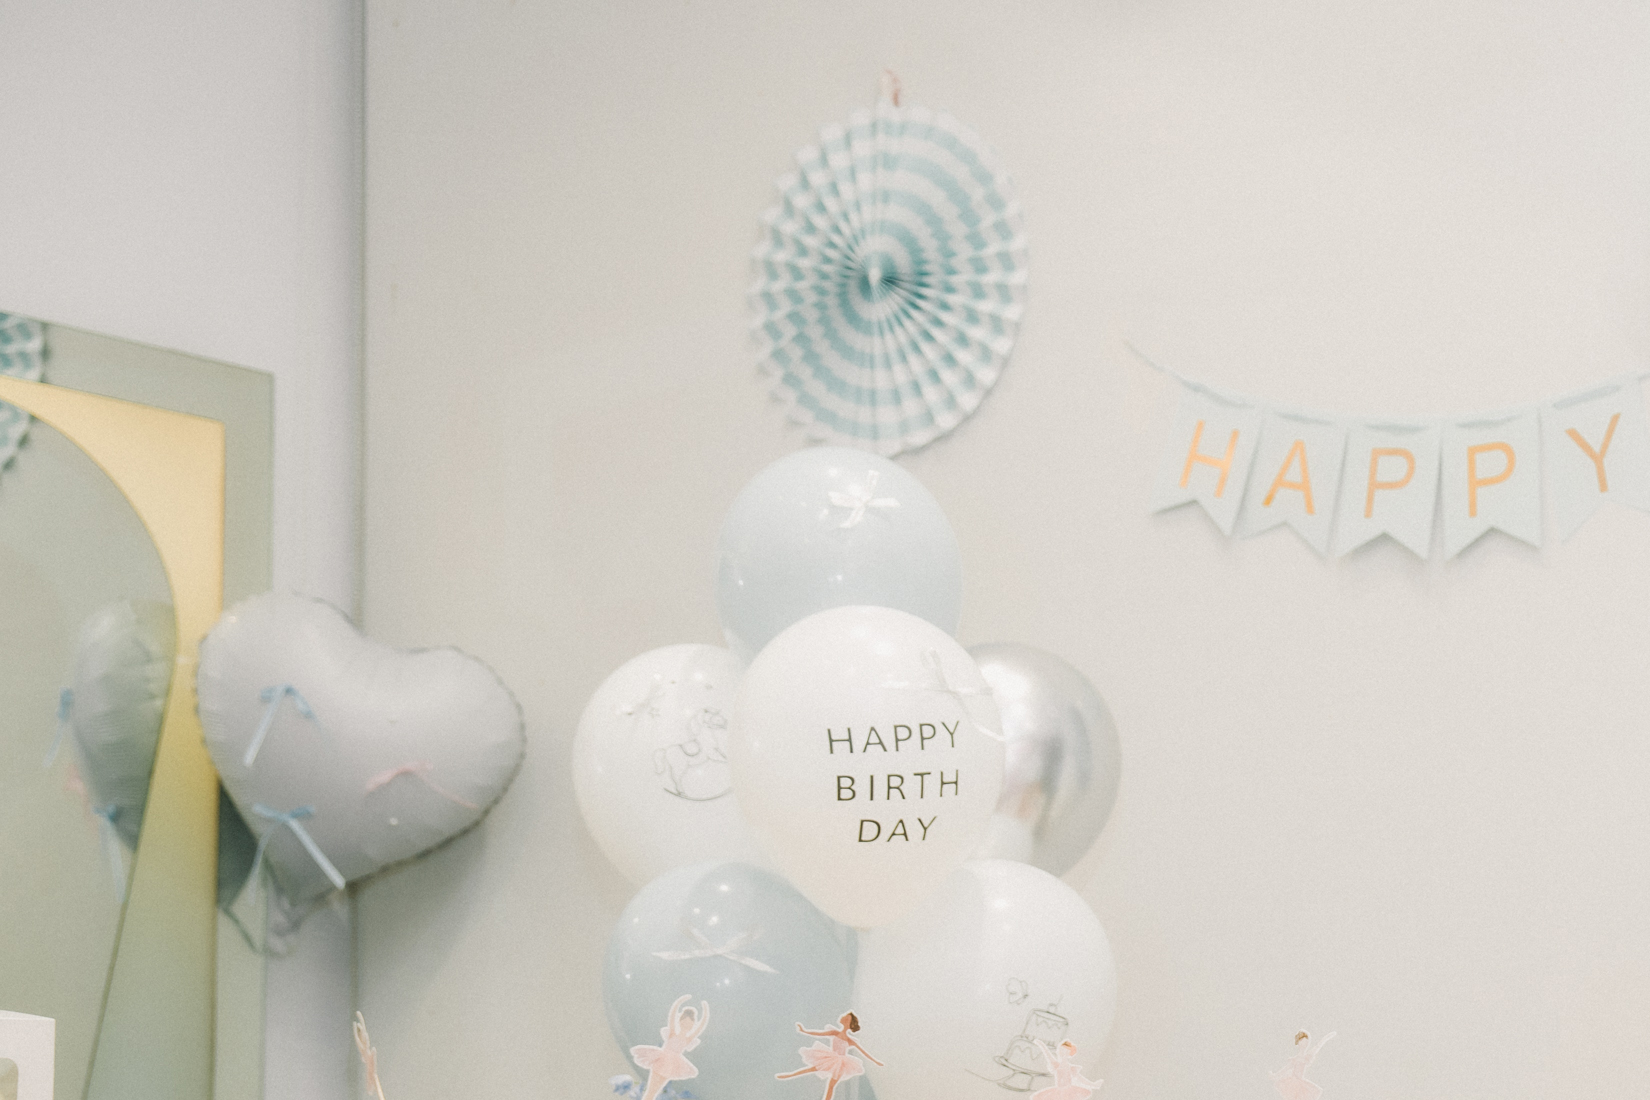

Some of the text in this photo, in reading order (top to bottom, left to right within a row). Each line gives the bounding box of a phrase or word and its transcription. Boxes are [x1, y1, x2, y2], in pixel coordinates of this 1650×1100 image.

[1178, 412, 1622, 519] HAPPY
[827, 720, 960, 755] HAPPY
[836, 769, 959, 801] BIRTH
[857, 816, 937, 843] DAY
